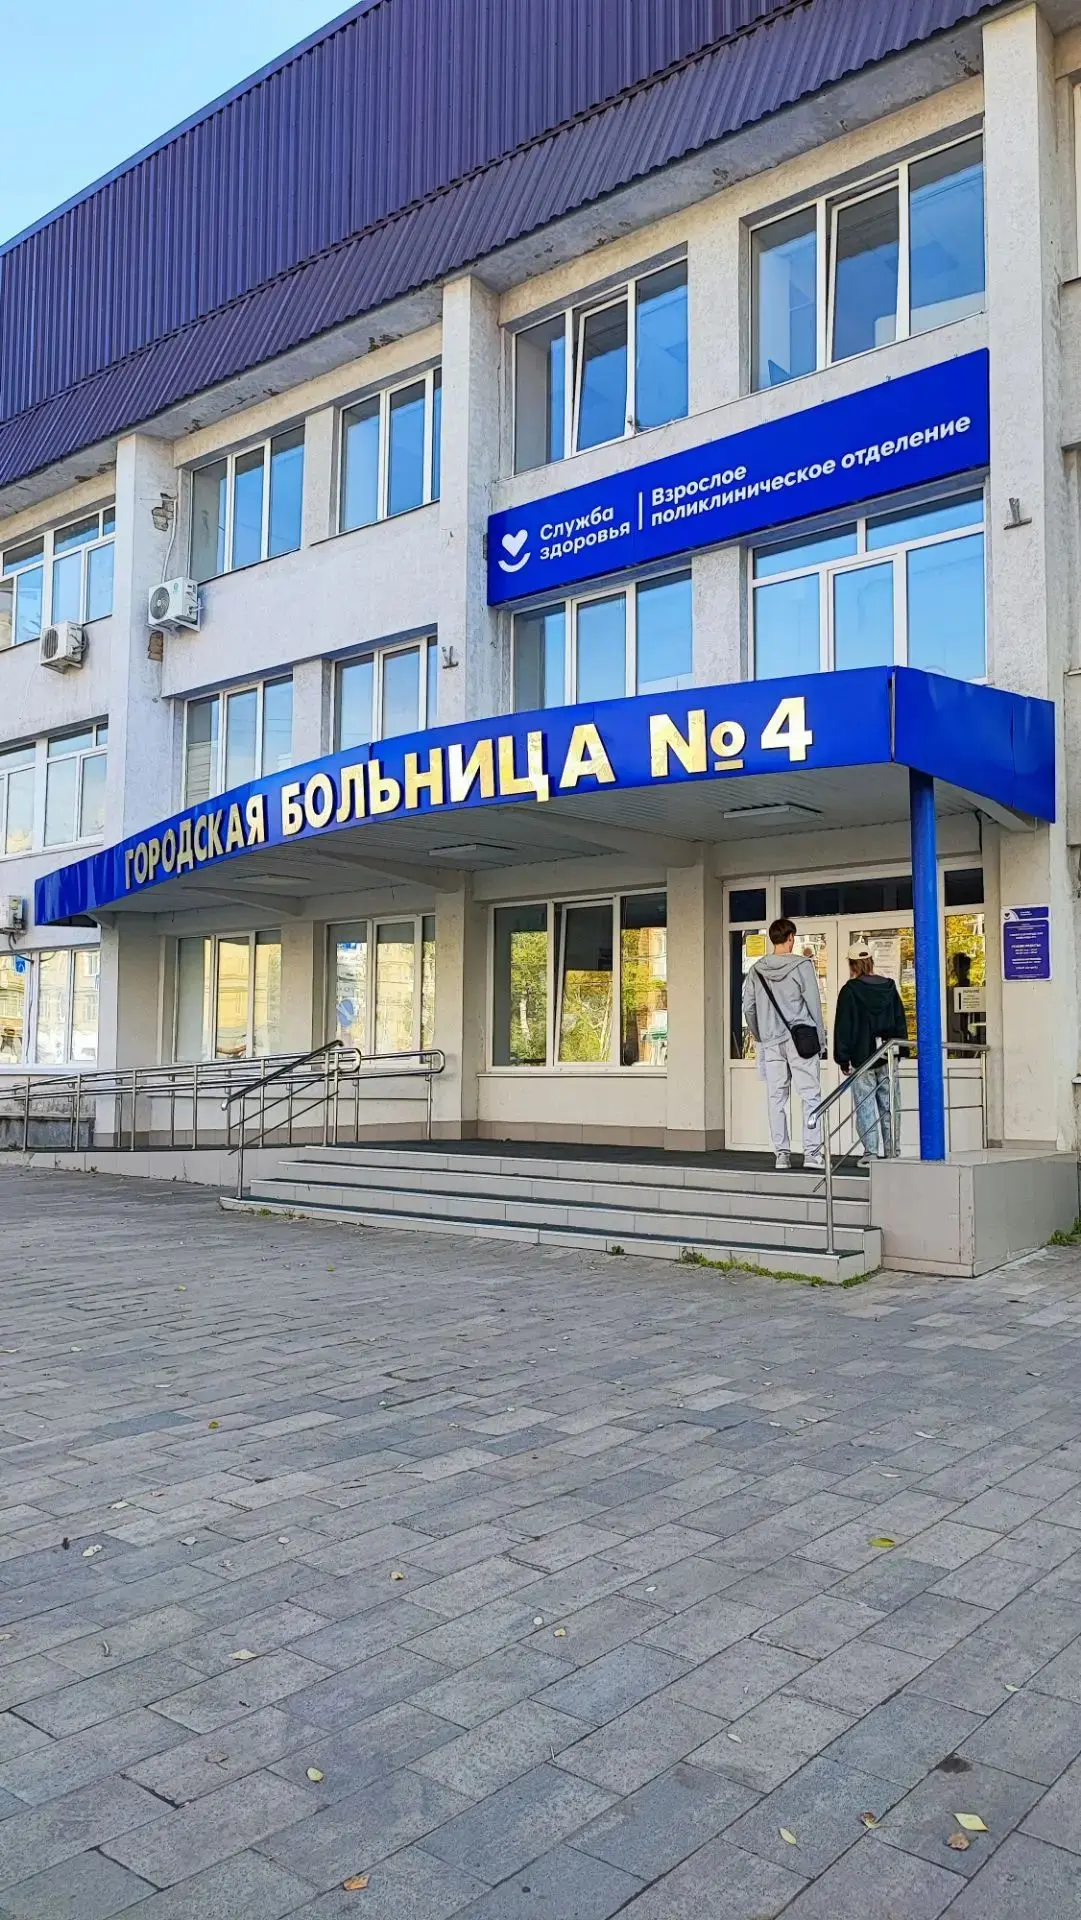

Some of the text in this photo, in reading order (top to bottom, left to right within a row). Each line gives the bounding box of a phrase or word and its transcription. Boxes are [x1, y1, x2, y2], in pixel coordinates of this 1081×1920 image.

[651, 415, 971, 527] поликлиническое отделение
[651, 465, 747, 506] Взрослое
[540, 506, 614, 540] Служба
[540, 521, 630, 560] здоровья
[124, 794, 266, 890] ГОРОДСКАЯ
[281, 723, 616, 836] БОЛЬНИЦА
